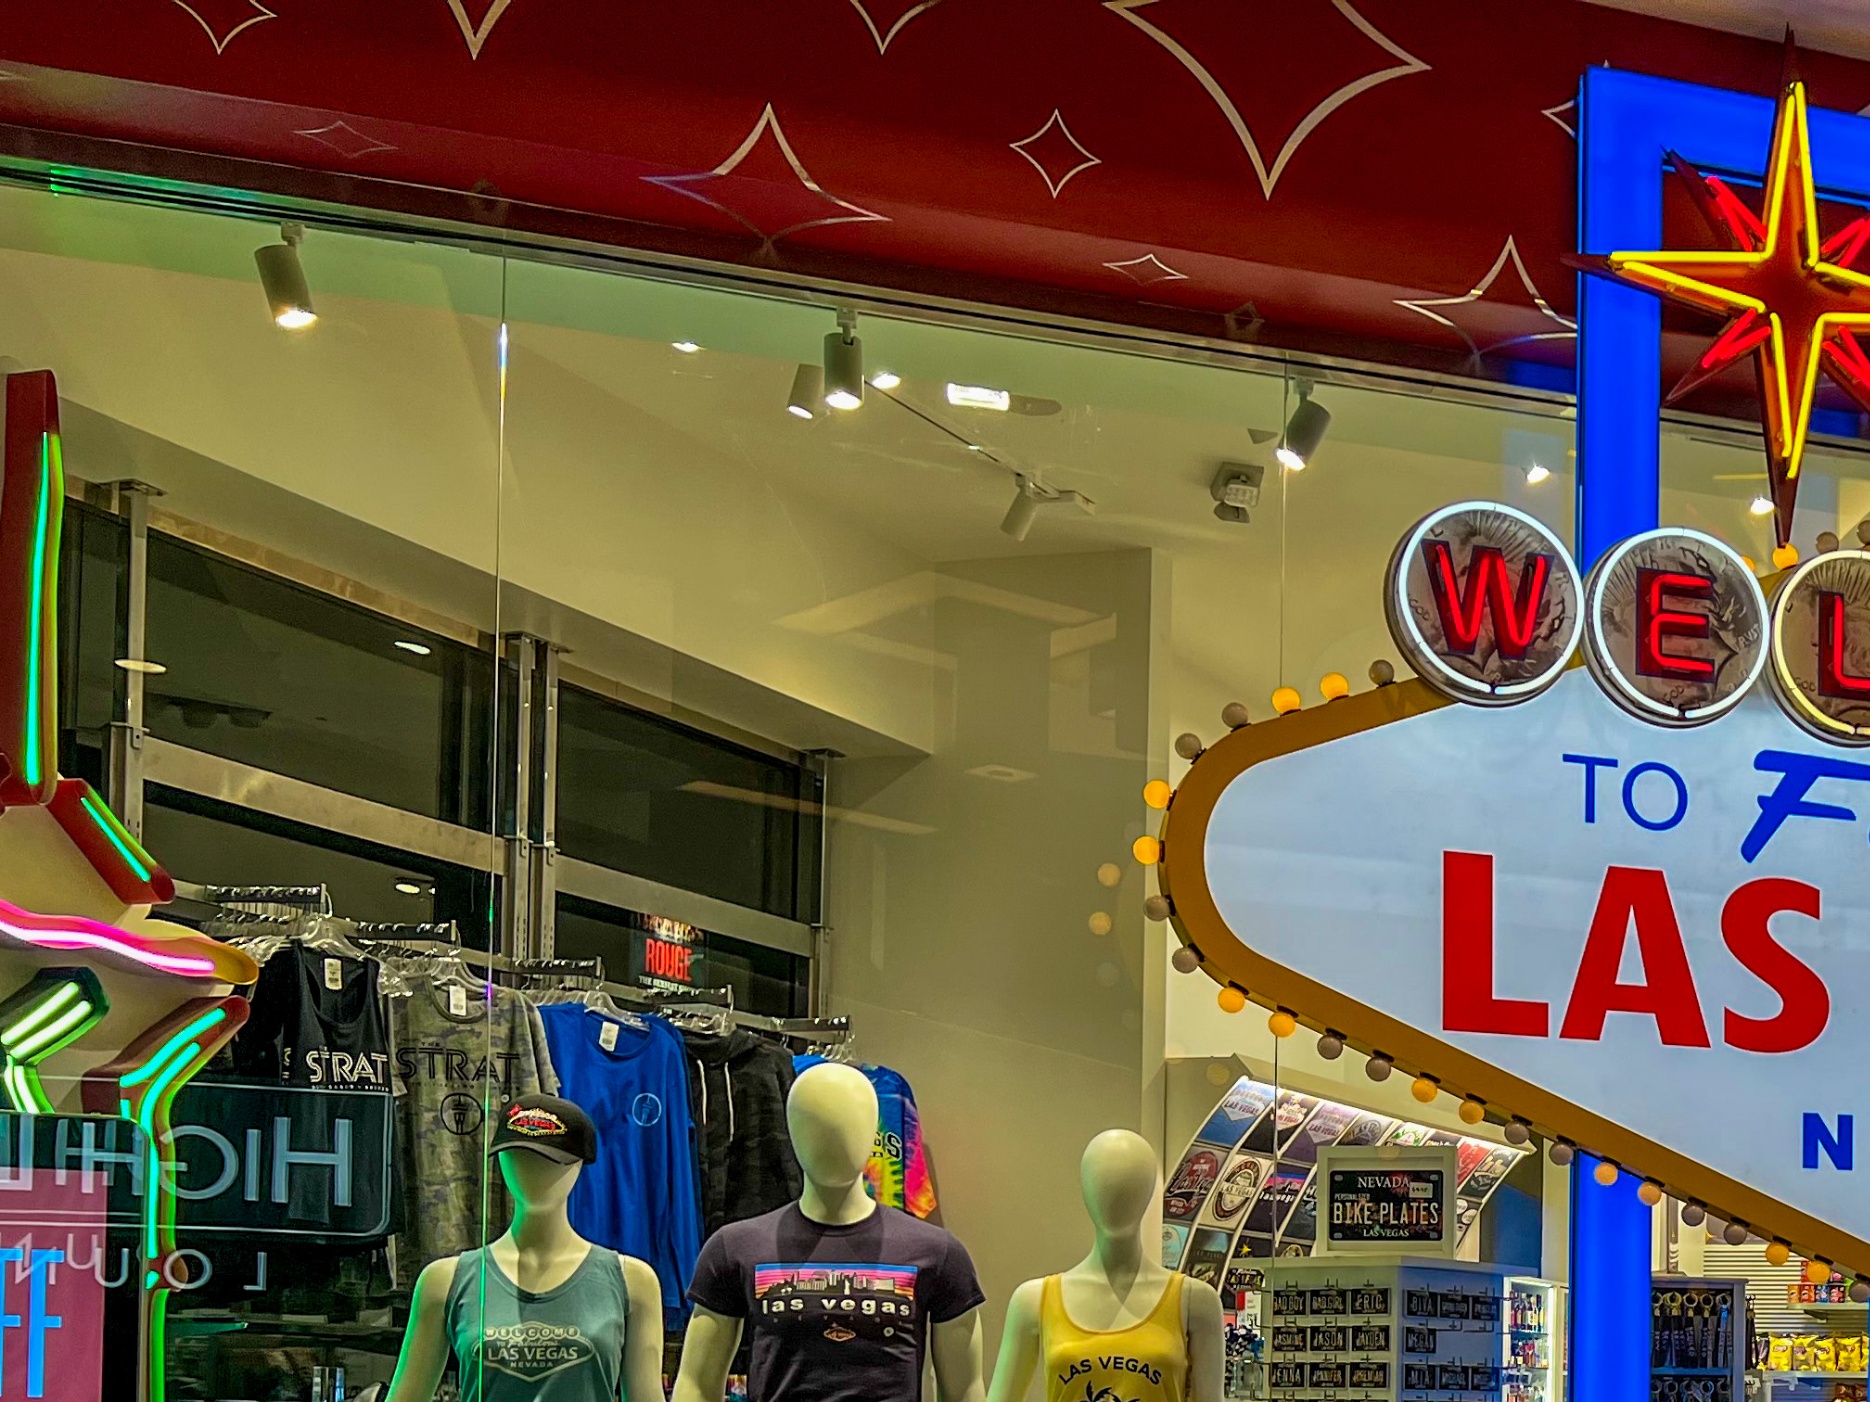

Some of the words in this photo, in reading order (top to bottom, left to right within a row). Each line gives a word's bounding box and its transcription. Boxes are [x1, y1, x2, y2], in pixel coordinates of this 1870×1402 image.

[1561, 753, 1689, 832] TO
[645, 938, 692, 981] ROUGE
[1442, 850, 1830, 1054] LAS
[306, 1048, 388, 1083] STRAT
[396, 1047, 520, 1090] STRAT
[1357, 1176, 1410, 1189] NEVADA
[1333, 1202, 1373, 1225] BIKE
[1379, 1202, 1439, 1225] PLATES
[1363, 1229, 1379, 1237] LAS
[1381, 1228, 1409, 1237] VEGAS
[763, 1299, 804, 1315] las
[821, 1298, 911, 1317] vegas
[1273, 1296, 1288, 1311] BAD
[1288, 1296, 1304, 1311] BOY
[1355, 1294, 1384, 1311] ERIC
[485, 1326, 578, 1338] WELCOME
[1313, 1332, 1344, 1347] JASON
[1356, 1331, 1385, 1347] JAYDEN
[1407, 1333, 1435, 1348] MEGAN
[488, 1347, 519, 1360] LAS
[524, 1347, 578, 1360] VEGAS
[1058, 1358, 1093, 1386] LAS
[1098, 1356, 1162, 1386] VEGAS
[1271, 1368, 1301, 1385] JENNA
